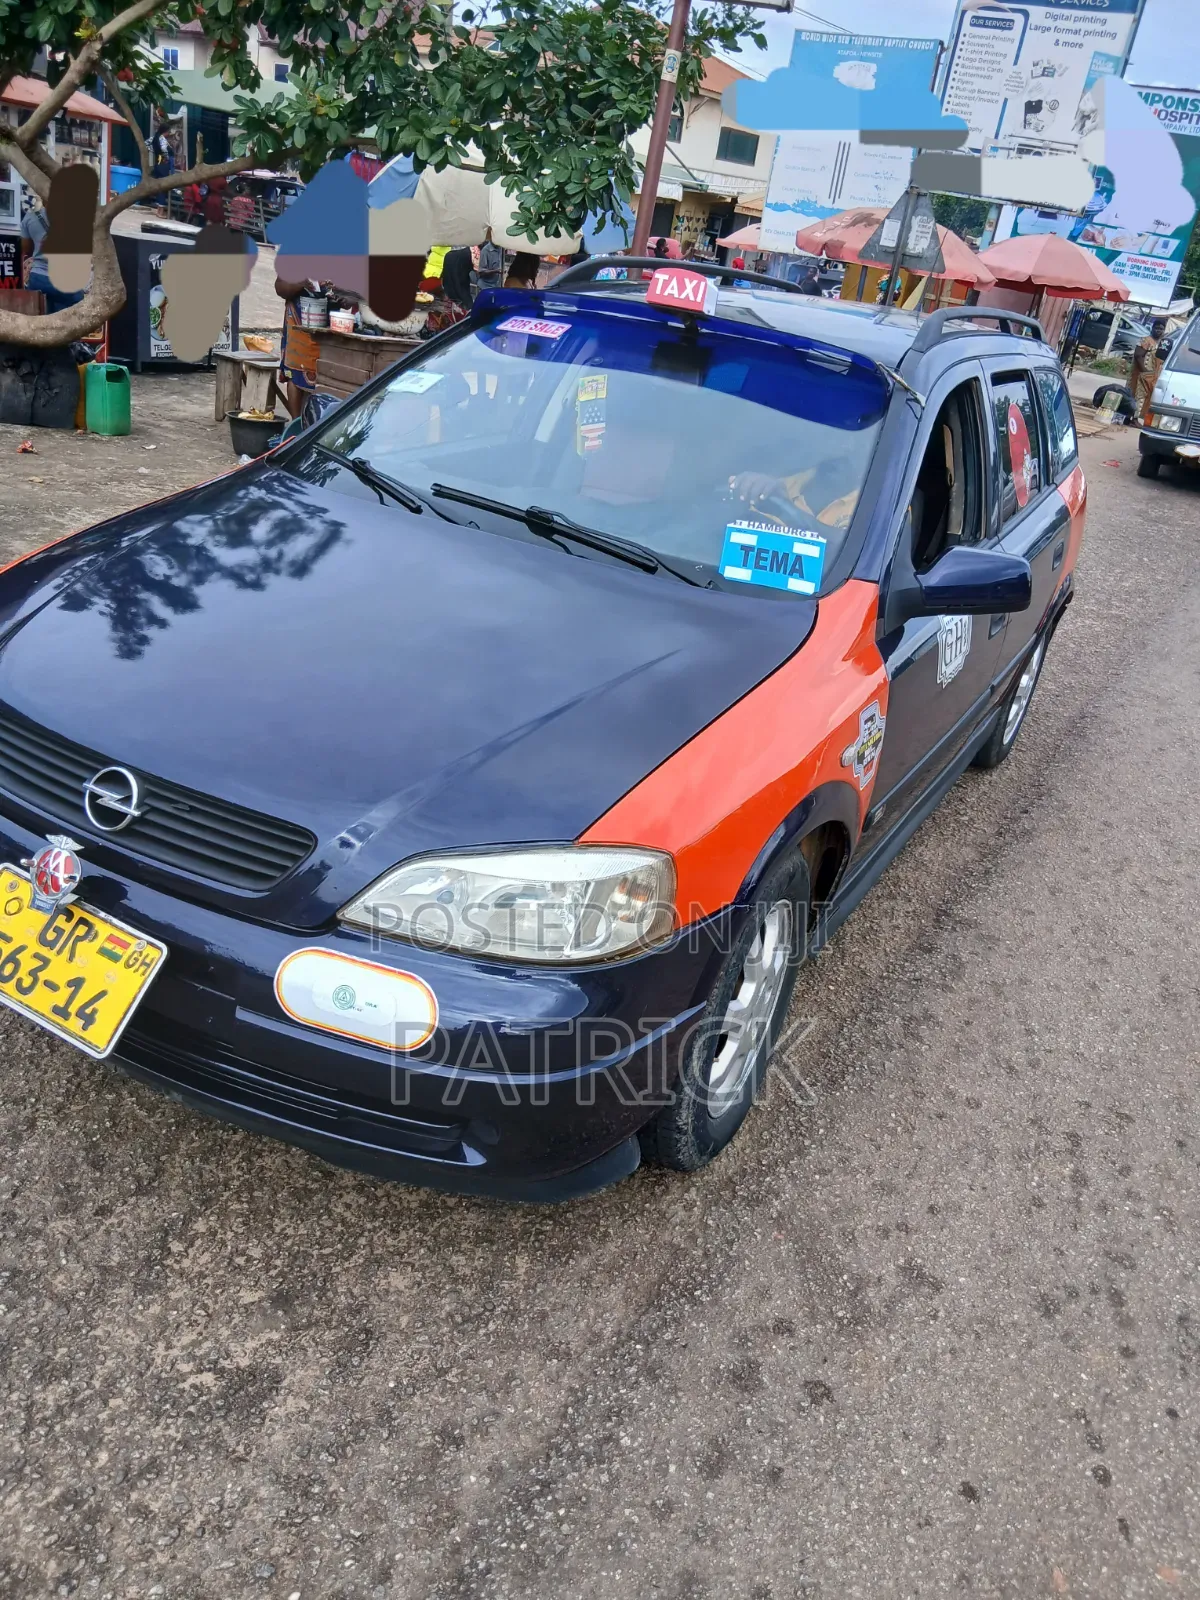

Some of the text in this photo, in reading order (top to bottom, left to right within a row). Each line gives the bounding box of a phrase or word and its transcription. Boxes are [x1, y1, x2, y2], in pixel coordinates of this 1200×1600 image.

[984, 20, 1014, 28] SERVICES
[1045, 11, 1108, 26] Digital printing
[1029, 23, 1118, 40] Large format printing
[908, 39, 934, 50] CHURCH
[991, 34, 1015, 44] Printing
[1054, 38, 1084, 49] & more
[984, 50, 1008, 59] Printing
[978, 58, 1002, 66] Designs
[960, 63, 1004, 74] Business Cards
[957, 78, 974, 86] Flyers
[955, 86, 1001, 97] Pull-up Banners
[1137, 91, 1200, 113] MPONS
[950, 108, 973, 116] Stickers
[1153, 108, 1200, 126] OSPIT
[0, 243, 16, 253] Y'S
[1127, 256, 1167, 268] WORKING HOURS
[654, 272, 706, 303] TAXI
[503, 318, 566, 335] FOR SALE
[746, 520, 808, 538] HAMBURG
[740, 544, 805, 579] TEMA
[38, 907, 97, 963] GR
[124, 950, 156, 978] GH
[0, 931, 109, 1032] 63-14
